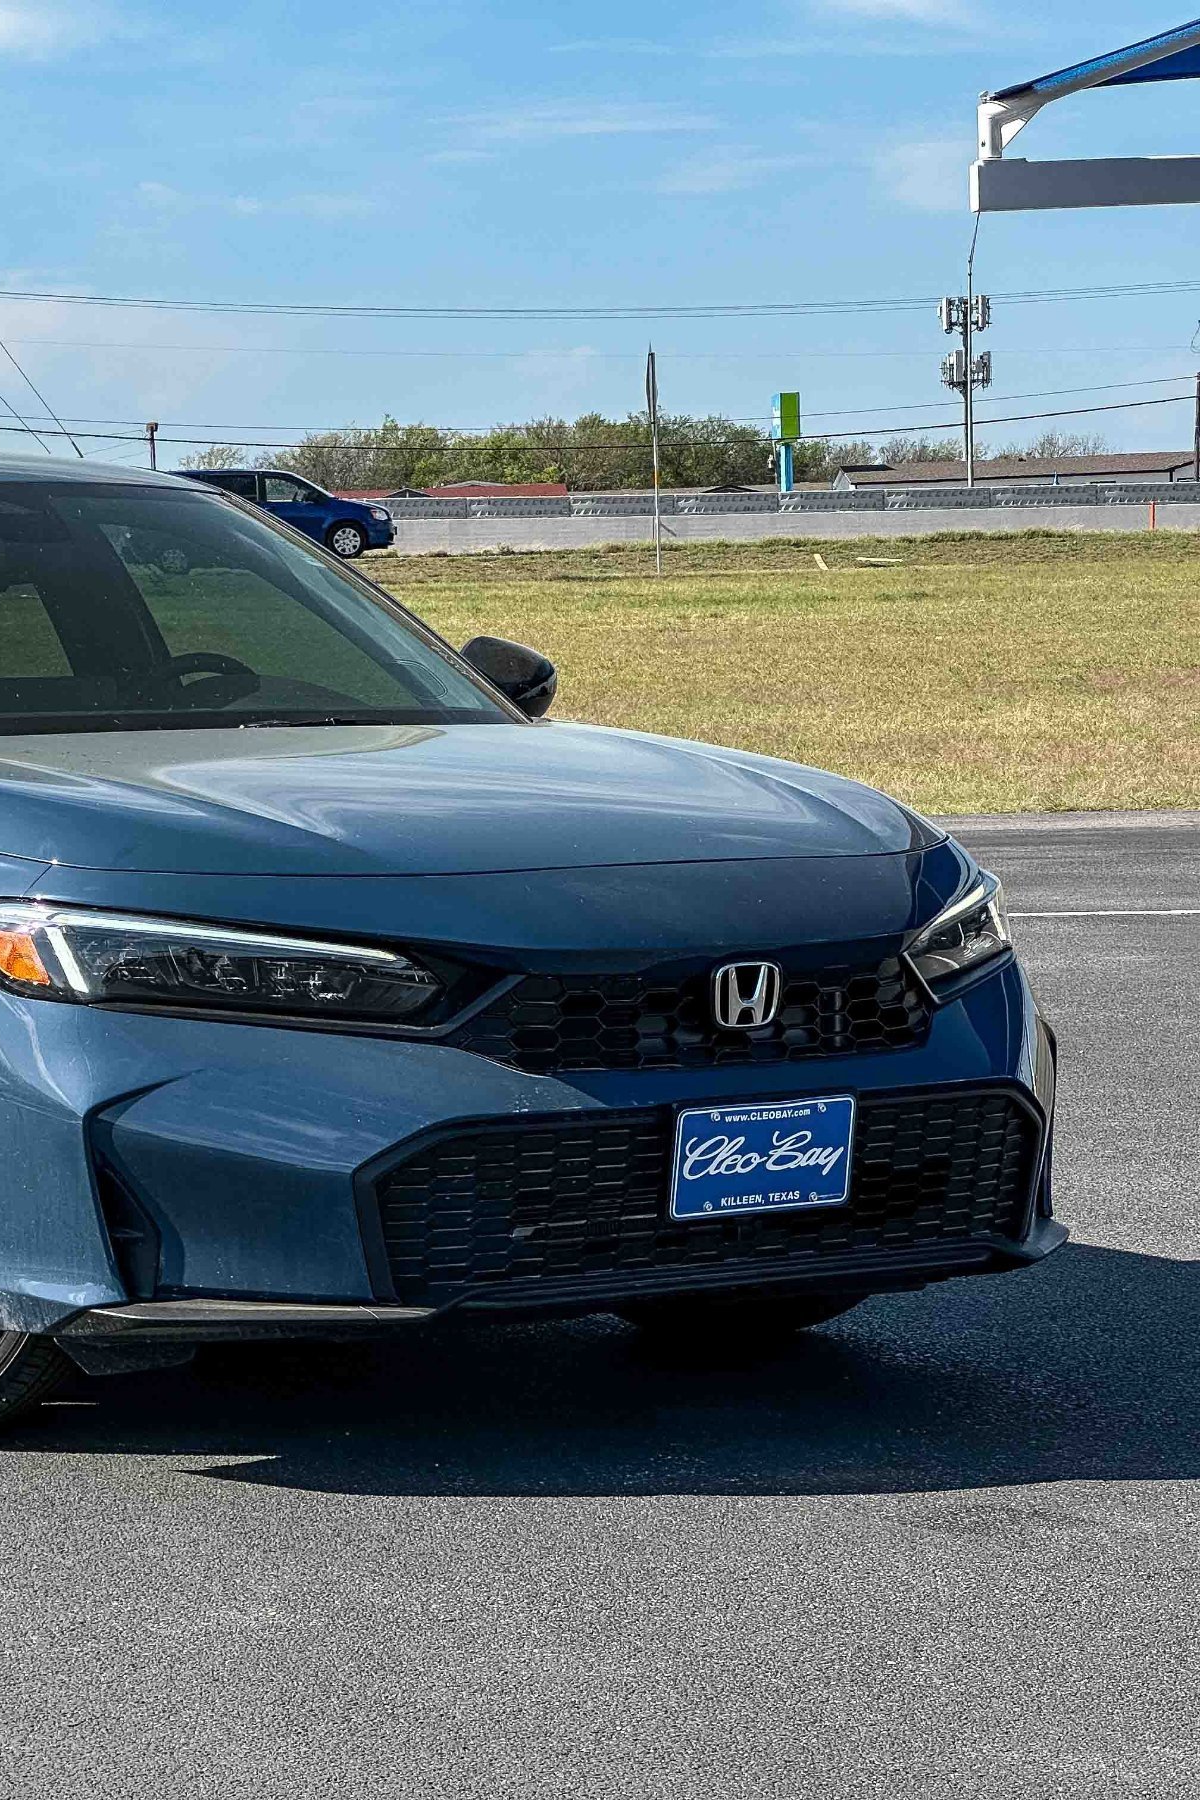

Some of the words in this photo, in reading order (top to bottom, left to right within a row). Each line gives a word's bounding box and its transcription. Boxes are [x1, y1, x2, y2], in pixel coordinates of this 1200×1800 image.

[724, 1107, 811, 1123] www.CLEOBAY.com
[682, 1135, 767, 1181] Cleo
[765, 1130, 844, 1176] Bay
[720, 1195, 765, 1207] KILLEEN,
[768, 1190, 801, 1203] TEXAS
